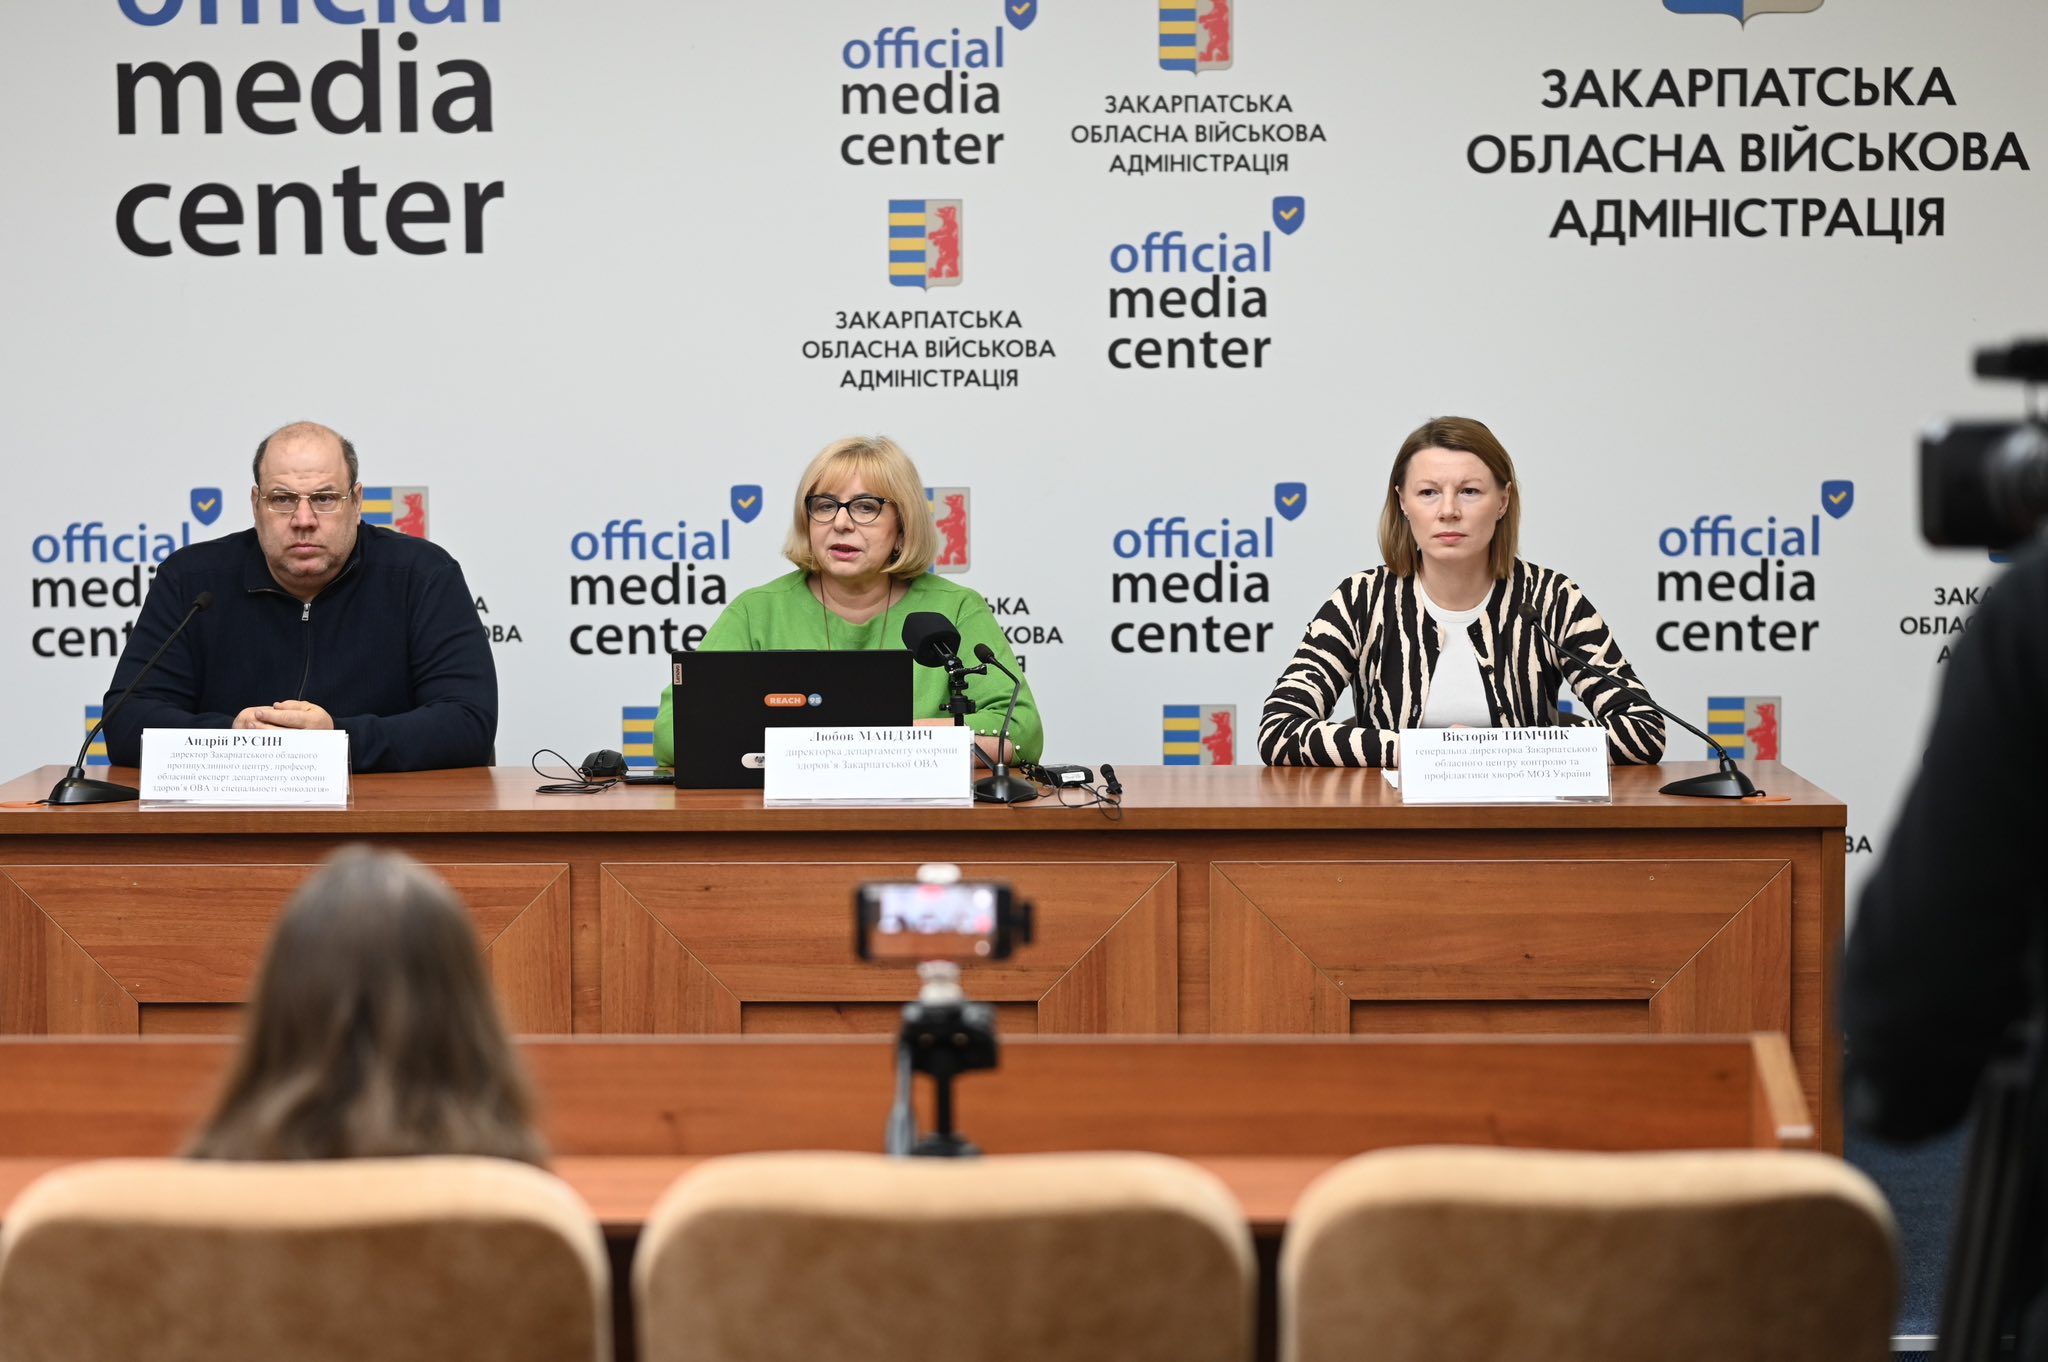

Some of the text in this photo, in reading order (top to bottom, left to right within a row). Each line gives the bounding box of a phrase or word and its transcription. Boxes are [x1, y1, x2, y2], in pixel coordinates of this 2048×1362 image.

[842, 25, 1003, 69] official
[116, 28, 493, 136] media
[842, 70, 1000, 115] media
[1541, 66, 1958, 109] ЗАКАРПАТСЬКА
[1105, 94, 1293, 114] ЗАКАРПАТСЬКА
[840, 127, 1004, 166] center
[1071, 121, 1327, 144] ОБЛАСНА ВІЙСЬКОВА
[1466, 124, 2031, 174] ОБЛАСНА ВІЙСЬКОВА
[1109, 154, 1289, 176] АДМІНІСТРАЦІЯ
[115, 165, 505, 257] center
[1548, 197, 1945, 246] АДМІНІСТРАЦІЯ
[1110, 230, 1271, 273] official
[1109, 274, 1267, 319] media
[835, 310, 1023, 330] ЗАКАРПАТСЬКА
[802, 337, 1056, 359] ОБЛАСНА ВІЙСЬКОВА
[1107, 331, 1271, 369] center
[839, 369, 1018, 391] АДМІНІСТРАЦІЯ
[32, 521, 191, 564] official
[570, 518, 730, 561] official
[1112, 516, 1273, 558] official
[1658, 514, 1820, 557] official
[32, 564, 157, 608] med
[570, 561, 727, 606] media
[1112, 559, 1270, 604] media
[1657, 557, 1816, 602] media
[569, 617, 708, 656] cente
[1110, 615, 1274, 654] center
[1655, 614, 1820, 653] center
[185, 736, 282, 748] Андрій РУСИН
[810, 731, 854, 742] Любов
[1442, 730, 1570, 743] Вікторія ТИМЧИК
[913, 760, 938, 768] ОВА
[1527, 770, 1550, 779] МОЗ
[1553, 770, 1591, 780] України
[190, 784, 210, 792] ОВА
